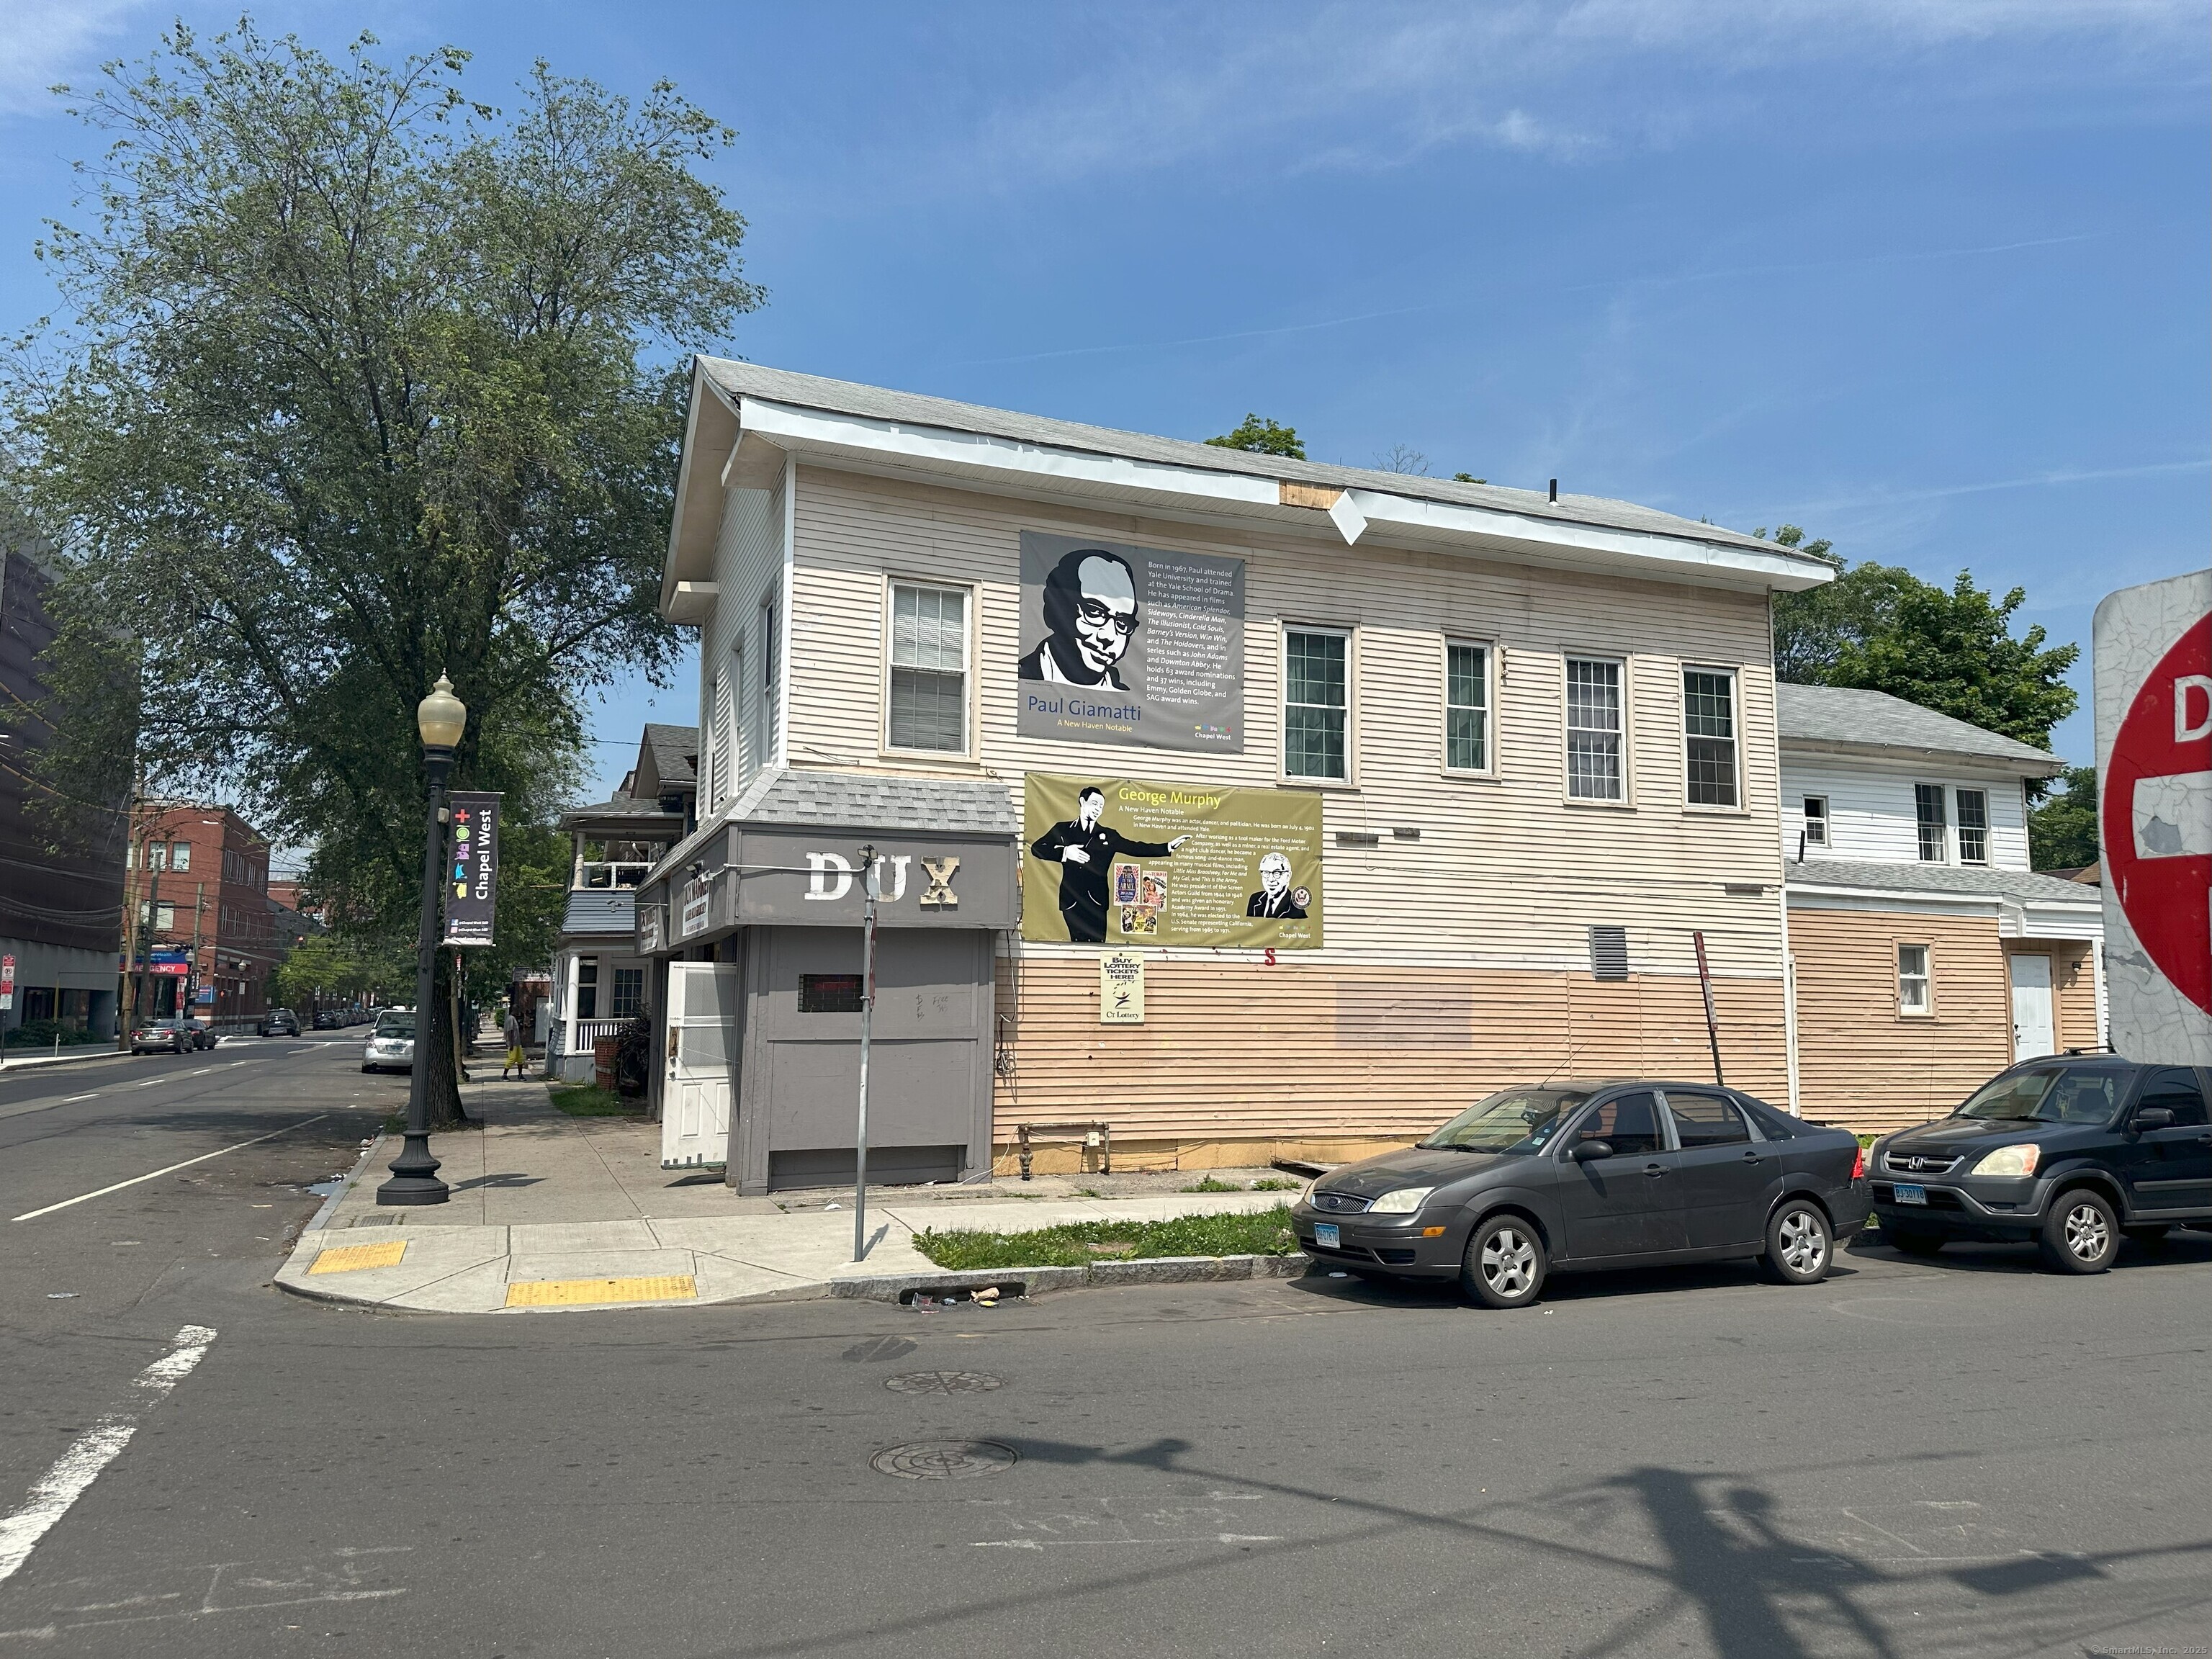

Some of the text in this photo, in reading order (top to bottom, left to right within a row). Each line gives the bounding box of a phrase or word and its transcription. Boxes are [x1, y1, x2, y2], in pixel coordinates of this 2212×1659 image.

[1172, 564, 1187, 574] 1967,
[1204, 568, 1232, 577] attended
[1163, 572, 1194, 583] University
[1182, 584, 1203, 593] School
[1213, 588, 1234, 596] Drama.
[1172, 592, 1200, 603] appeared
[1172, 602, 1202, 611] American
[1203, 605, 1230, 616] Splendor,
[1148, 608, 1226, 625] Sideways, Cinderella Man,
[1161, 619, 1191, 630] Illusionist,
[1208, 624, 1224, 634] Souls,
[1147, 627, 1173, 638] Barney's
[1175, 631, 1198, 641] Version,
[1214, 634, 1227, 644] Win,
[1173, 639, 1205, 650] Holdovers,
[1161, 657, 1190, 666] Downton
[1190, 660, 1211, 670] Abbey.
[1166, 667, 1173, 675] 63
[1196, 670, 1235, 680] nominations
[1168, 677, 1184, 686] wins,
[1187, 679, 1215, 690] including
[1147, 684, 1168, 693] Emmy,
[1193, 688, 1213, 698] Globe,
[1028, 696, 1141, 720] Paul Giamatti
[1082, 721, 1103, 730] Haven
[1106, 724, 1132, 732] Notable
[1119, 788, 1221, 809] George Murphy
[475, 809, 493, 900] Chapel West
[804, 852, 960, 904] DUX
[1265, 948, 1276, 966] S
[1117, 1011, 1139, 1020] Lottery
